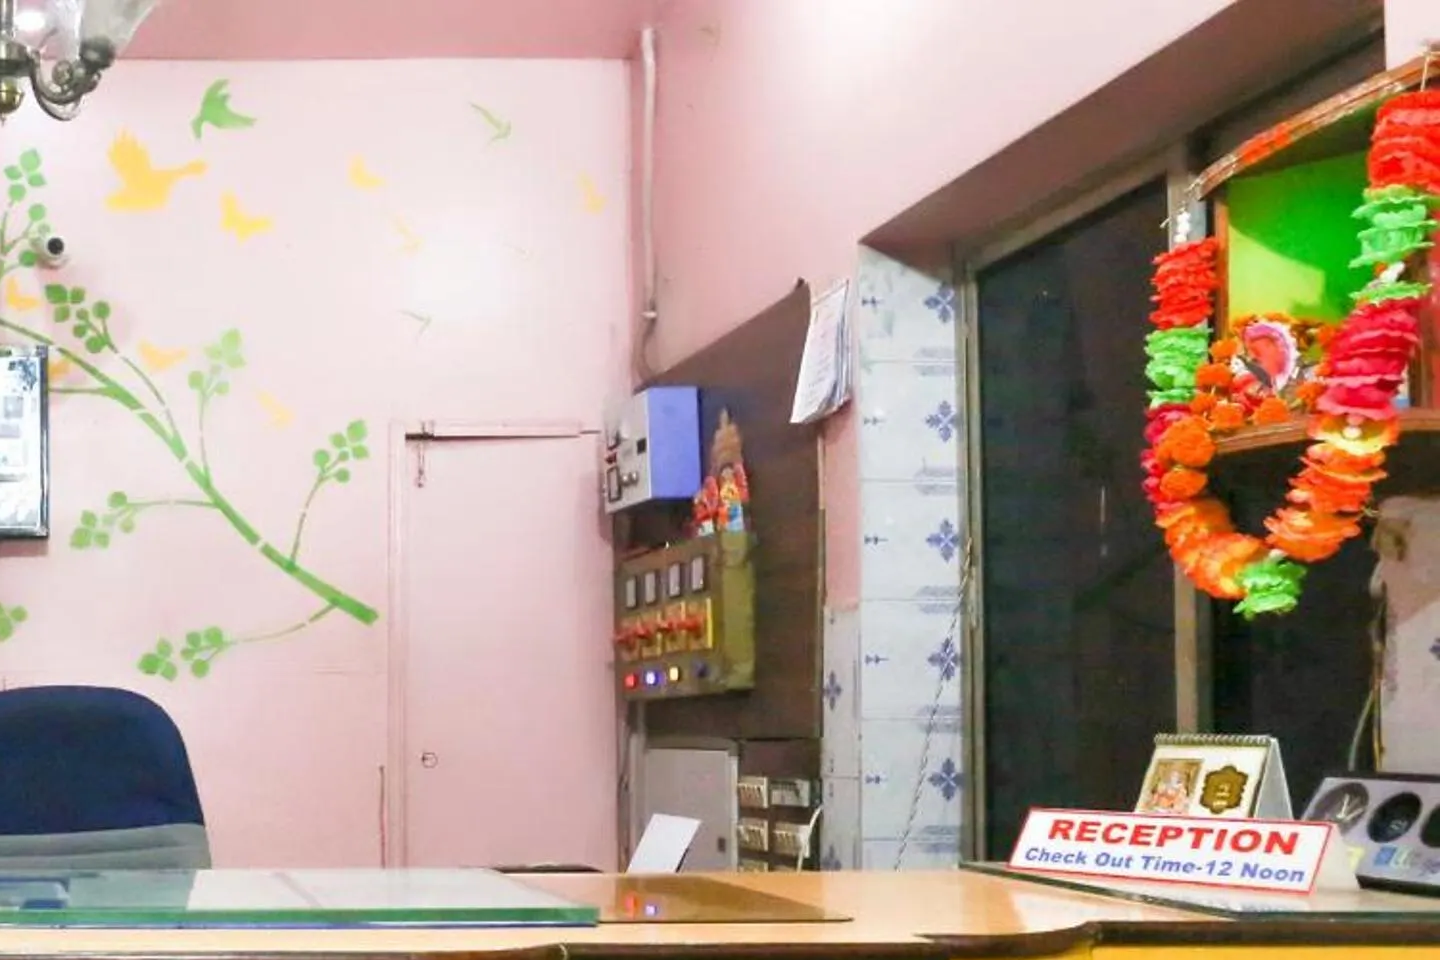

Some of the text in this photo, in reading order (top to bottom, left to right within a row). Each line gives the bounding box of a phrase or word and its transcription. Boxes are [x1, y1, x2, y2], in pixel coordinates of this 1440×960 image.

[1048, 819, 1299, 855] RECEPTION
[1025, 847, 1305, 882] Check Out Time-12 Noon
